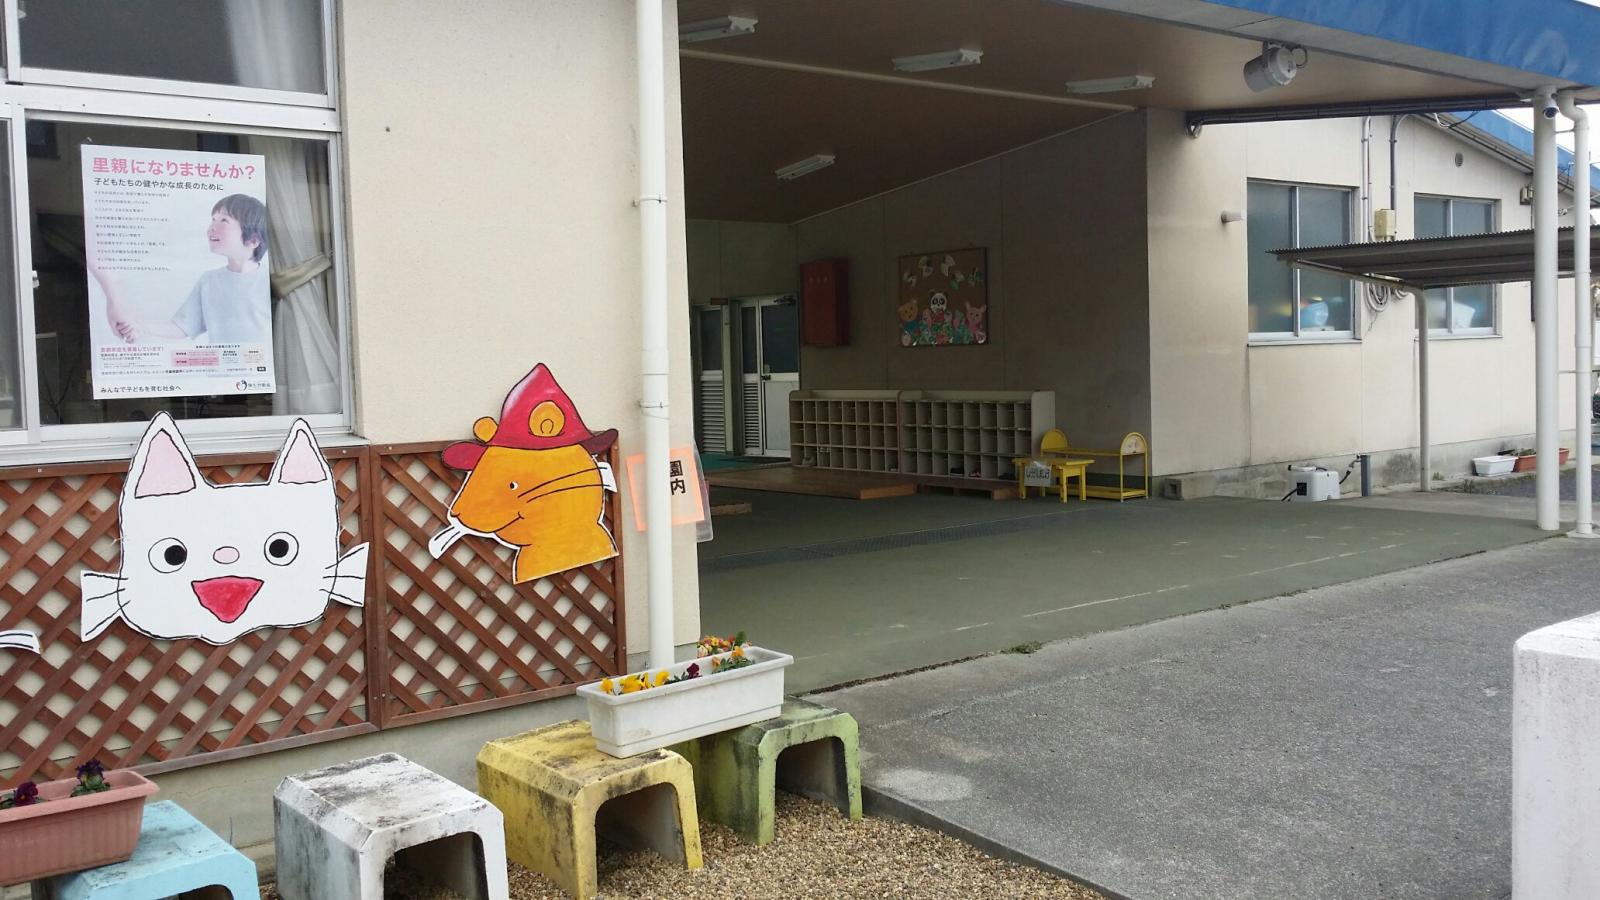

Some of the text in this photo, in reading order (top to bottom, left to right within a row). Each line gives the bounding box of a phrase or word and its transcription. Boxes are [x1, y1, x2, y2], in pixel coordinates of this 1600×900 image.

[92, 157, 256, 180] 里親になりませんか?
[94, 177, 224, 191] 子どもたちの健やかな成長のために
[100, 385, 182, 394] みんなで子どもを育む社会へ
